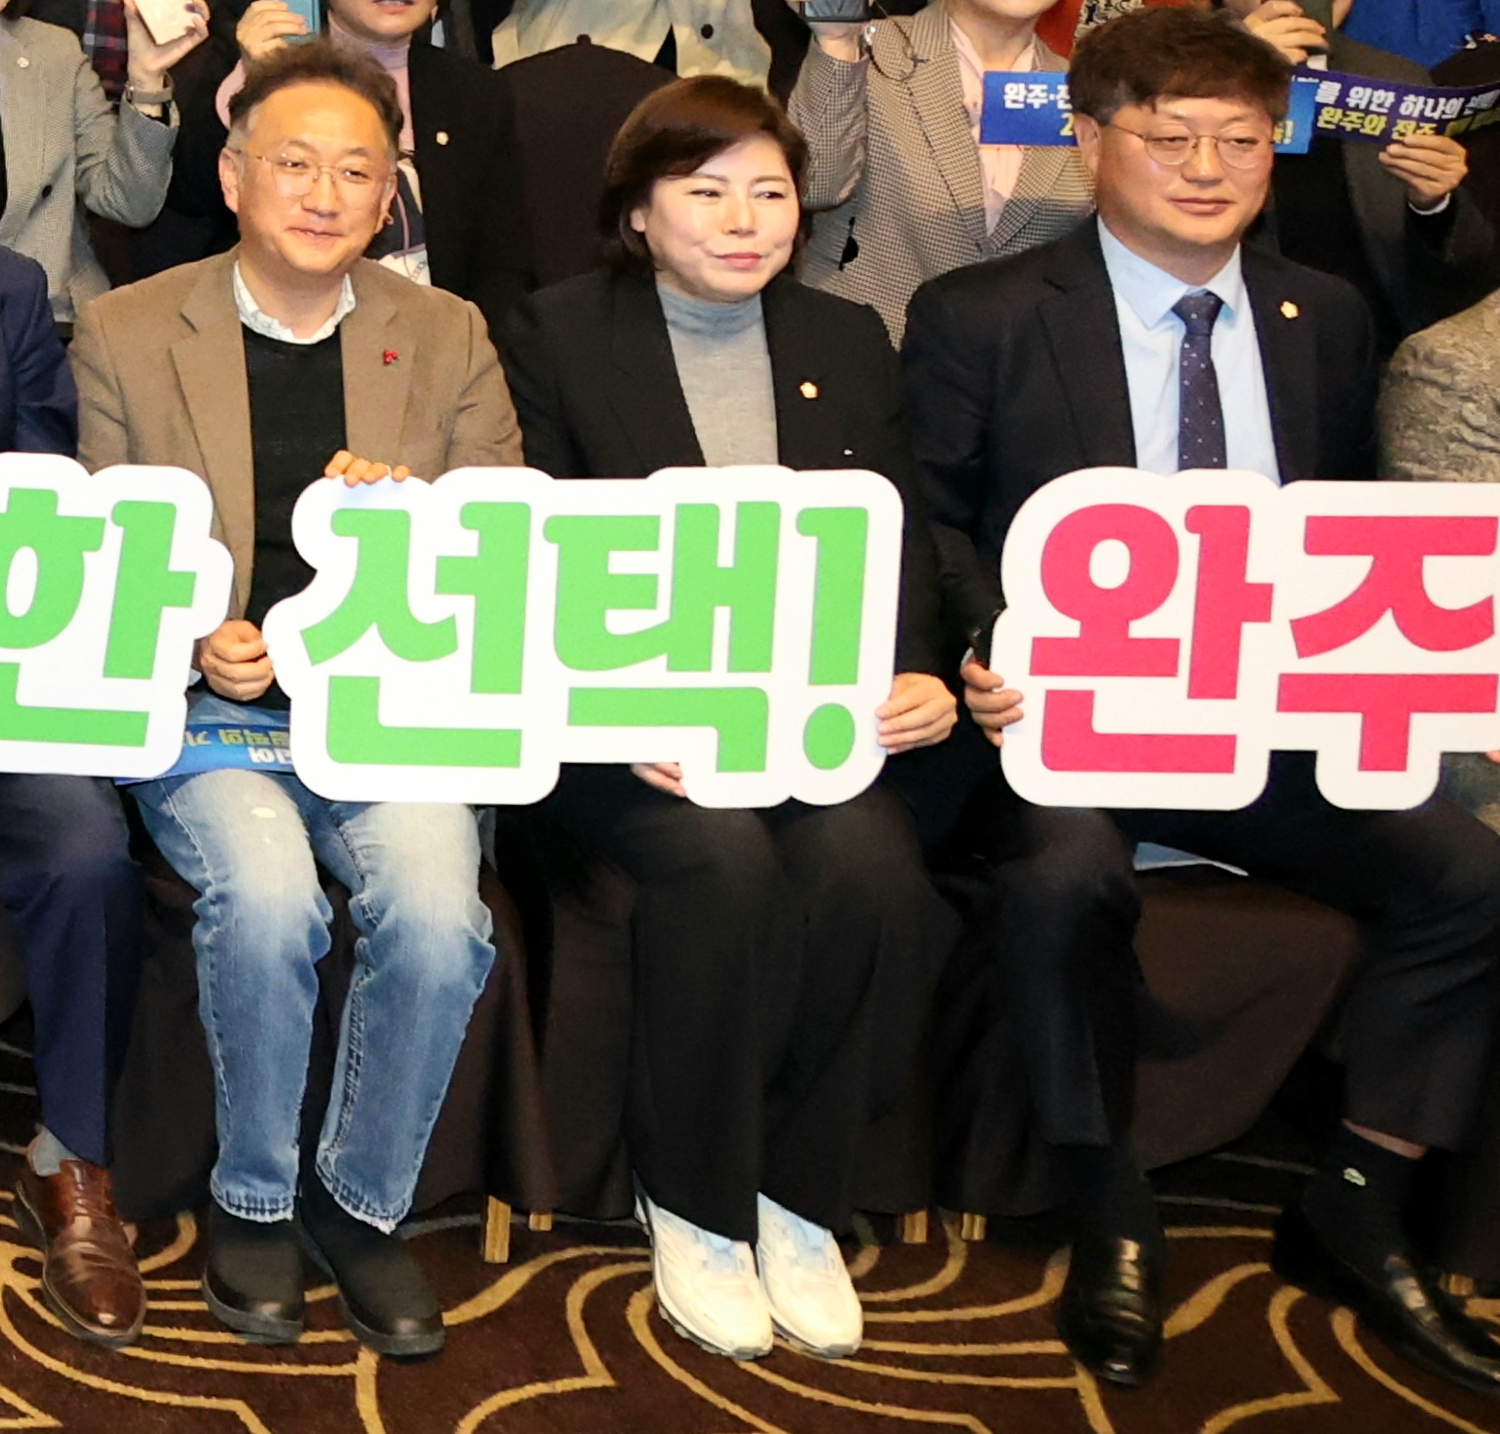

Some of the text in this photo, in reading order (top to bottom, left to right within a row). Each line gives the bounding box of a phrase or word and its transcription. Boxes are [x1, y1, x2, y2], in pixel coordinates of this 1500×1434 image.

[1317, 106, 1387, 137] 완주와
[1346, 85, 1465, 119] 위한 하나의
[302, 500, 870, 770] 선택!
[1031, 503, 1500, 771] 완주
